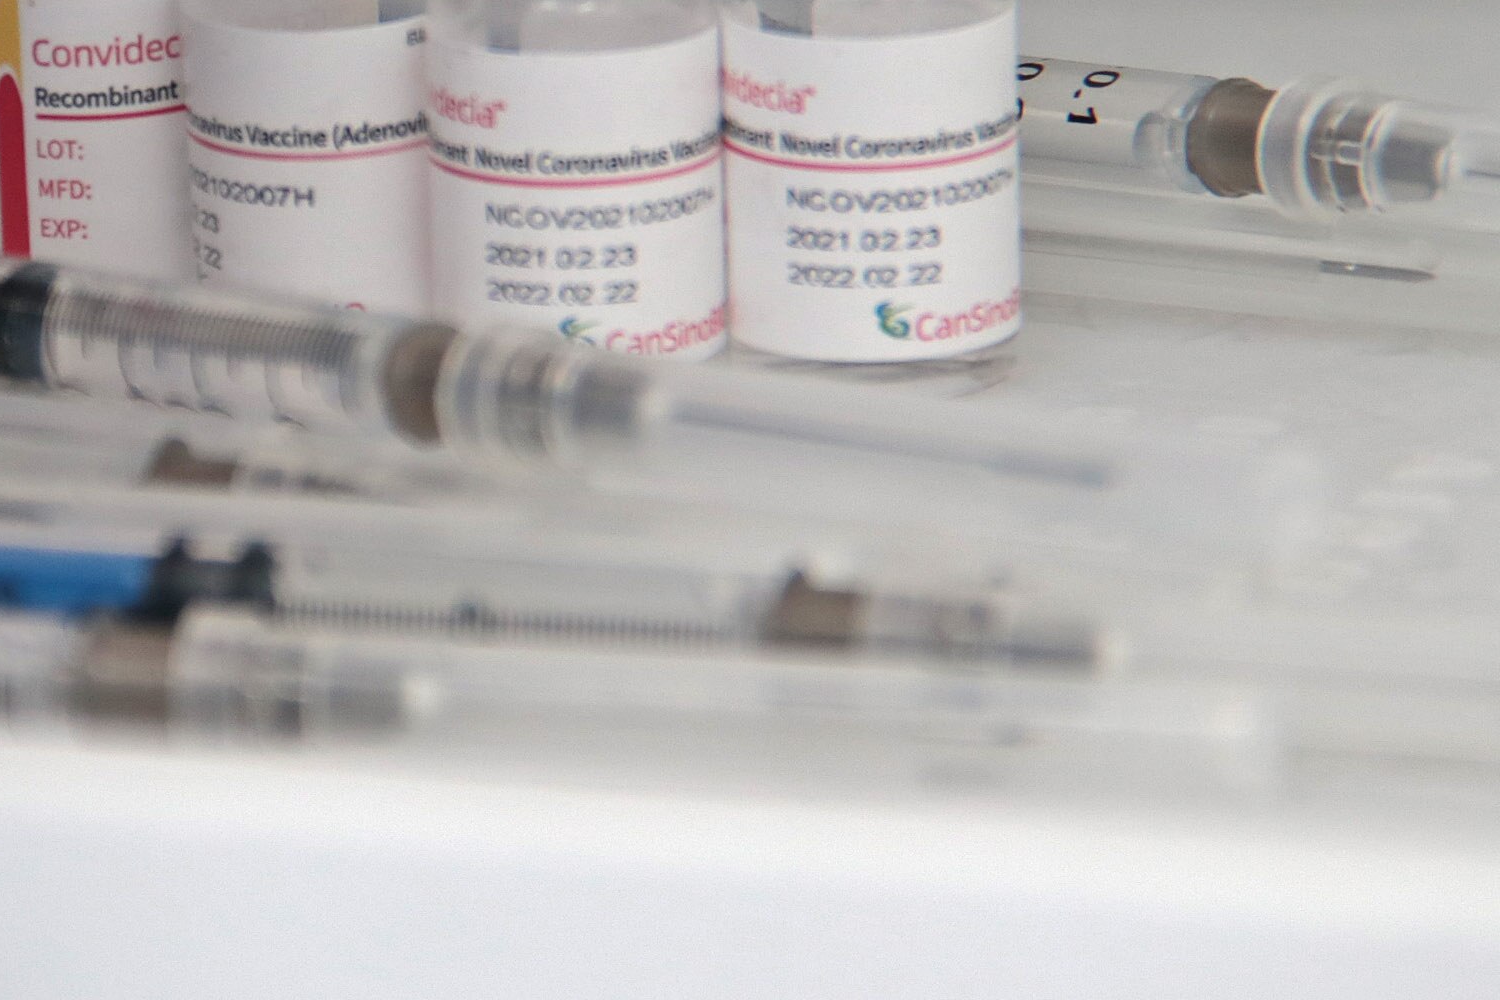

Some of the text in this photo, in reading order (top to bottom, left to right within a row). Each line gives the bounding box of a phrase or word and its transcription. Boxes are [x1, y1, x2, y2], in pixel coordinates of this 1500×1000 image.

[34, 80, 179, 109] Recombinant
[35, 137, 85, 161] LOT:
[244, 123, 327, 149] Vaccine
[779, 131, 839, 157] Novel
[844, 126, 975, 159] Coronavirus
[474, 147, 531, 173] Novel
[536, 143, 668, 175] Coronavirus
[37, 177, 92, 201] MFD:
[39, 217, 88, 240] EXP:
[786, 226, 850, 250] 2021
[485, 241, 546, 269] 2021
[787, 262, 854, 289] 2022
[486, 275, 551, 306] 2022
